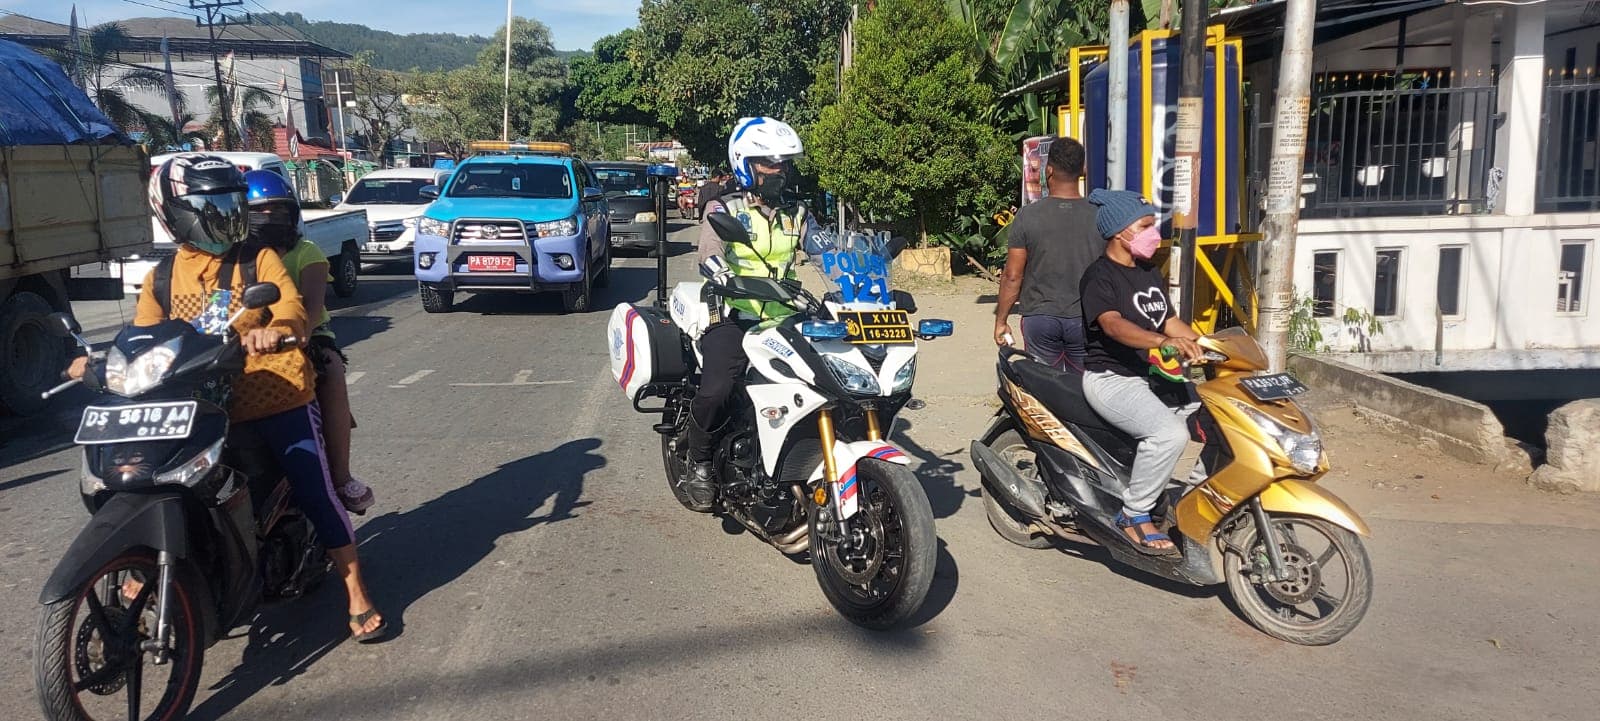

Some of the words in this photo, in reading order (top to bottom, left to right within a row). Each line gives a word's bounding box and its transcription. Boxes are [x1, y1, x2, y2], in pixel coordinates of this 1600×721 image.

[822, 251, 889, 275] POLISI
[834, 274, 890, 305] 121
[869, 328, 907, 339] 16-3228
[85, 411, 110, 427] DS
[167, 406, 190, 421] AA
